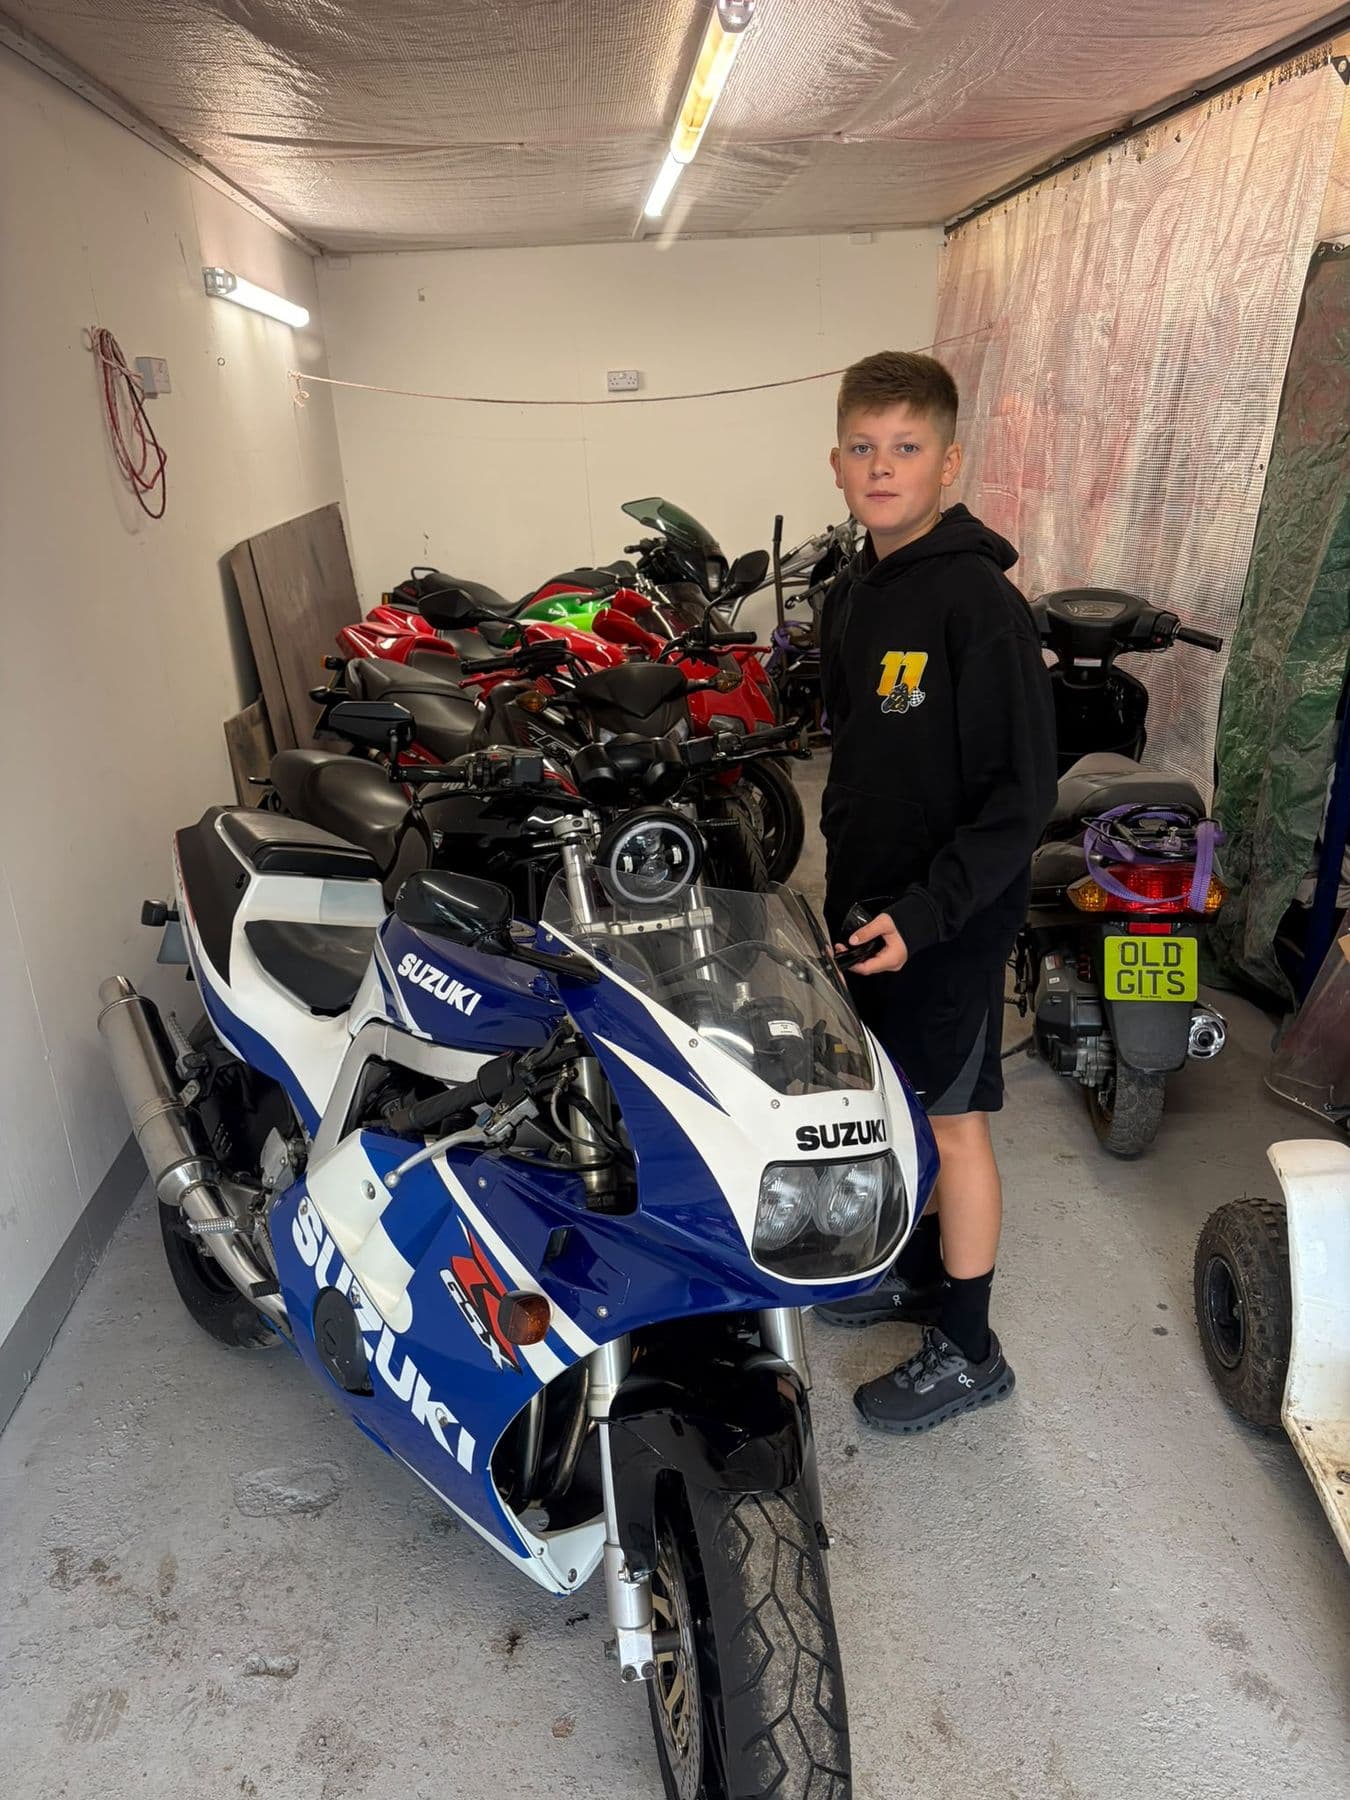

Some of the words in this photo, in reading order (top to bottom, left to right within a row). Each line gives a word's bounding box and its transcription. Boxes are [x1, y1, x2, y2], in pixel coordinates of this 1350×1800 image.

[1120, 941, 1182, 967] OLD
[397, 952, 482, 1017] SUZUKI
[1116, 969, 1186, 996] GITS
[795, 1118, 888, 1152] SUZUKI
